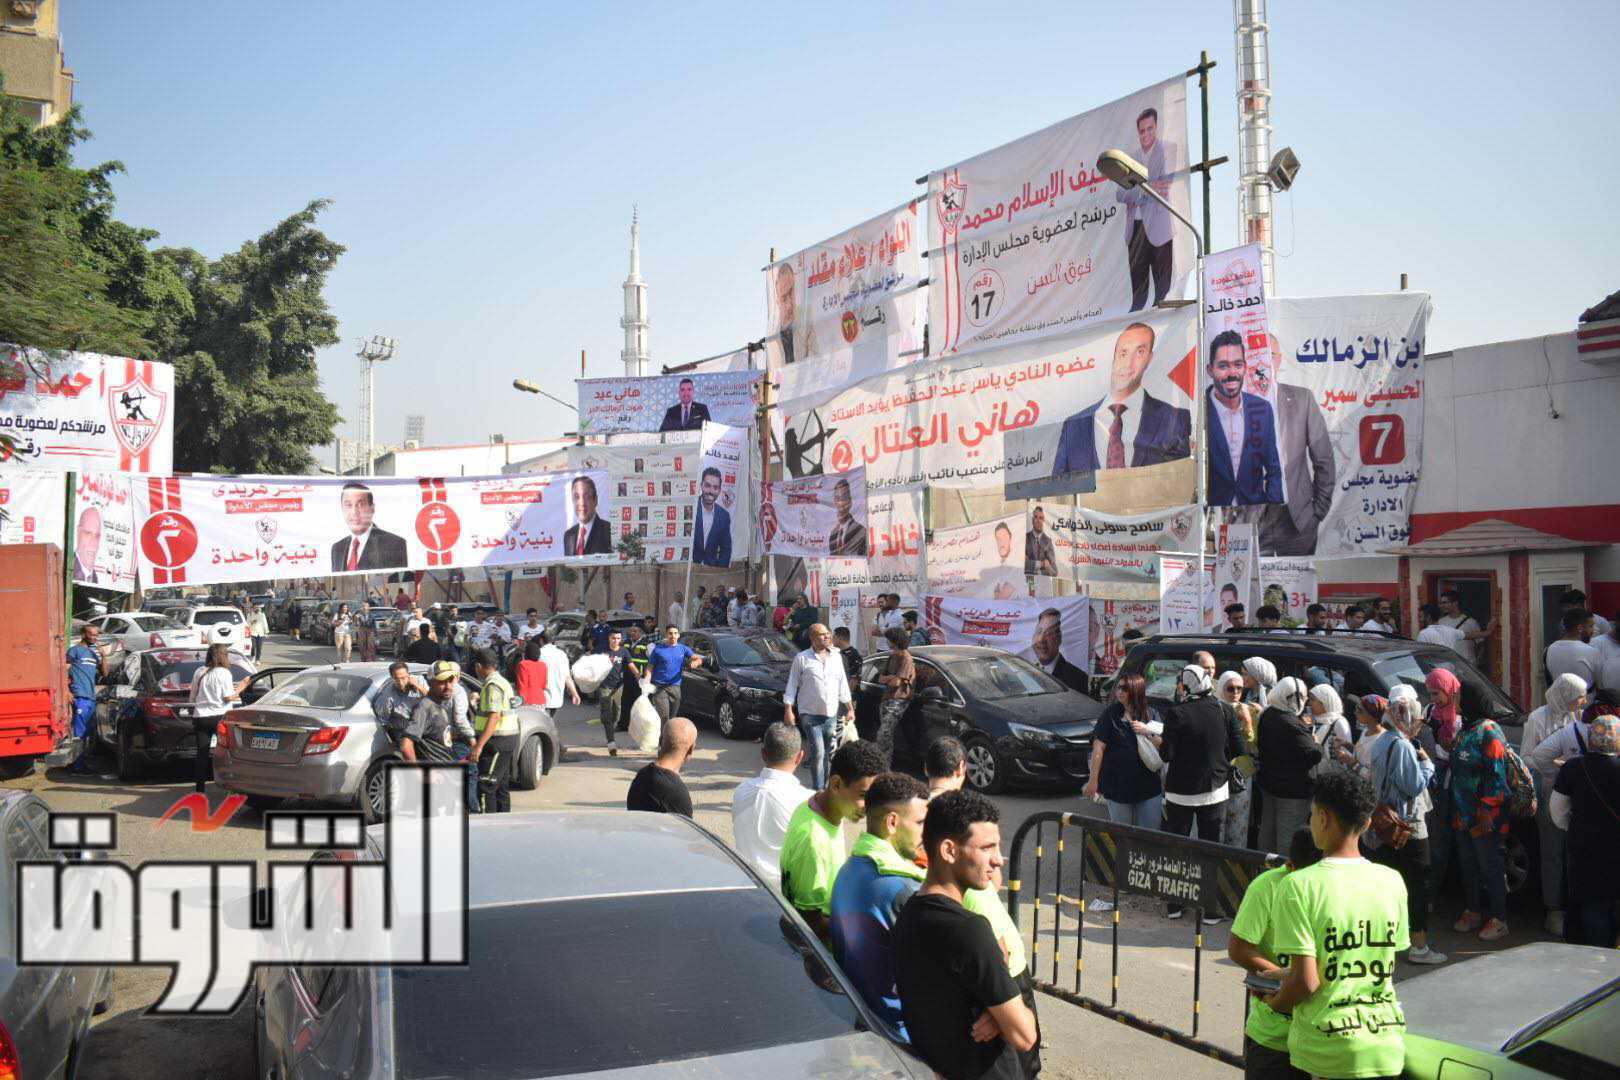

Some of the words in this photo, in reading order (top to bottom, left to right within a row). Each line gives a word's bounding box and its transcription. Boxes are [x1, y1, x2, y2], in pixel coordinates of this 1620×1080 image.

[1069, 160, 1112, 193] يف
[961, 201, 1005, 231] محمد
[1033, 211, 1078, 241] لعضوية
[1081, 204, 1117, 231] مرشح
[992, 233, 1030, 259] مجلس
[972, 276, 993, 289] رقم
[970, 290, 996, 320] 17
[1207, 298, 1235, 314] خالد
[1296, 334, 1390, 370] الزمالك
[1004, 363, 1051, 391] النادي
[1055, 356, 1096, 378] عضو
[971, 374, 1002, 395] ياسر
[1320, 385, 1358, 411] سمير
[15, 415, 58, 431] لعضوية
[59, 420, 106, 435] مرشحكم
[958, 400, 1041, 458] هاني
[861, 412, 948, 464] العتال
[1371, 421, 1393, 459] 7
[928, 467, 955, 480] نائب
[1006, 451, 1043, 470] المرشح
[1341, 473, 1375, 492] مجلس
[471, 534, 517, 551] واحدة
[519, 531, 554, 549] بنية
[211, 546, 270, 567] واحدة
[1127, 869, 1152, 891] GIZA
[1156, 875, 1201, 902] TRAFFIC
[1323, 920, 1396, 954] قائمة
